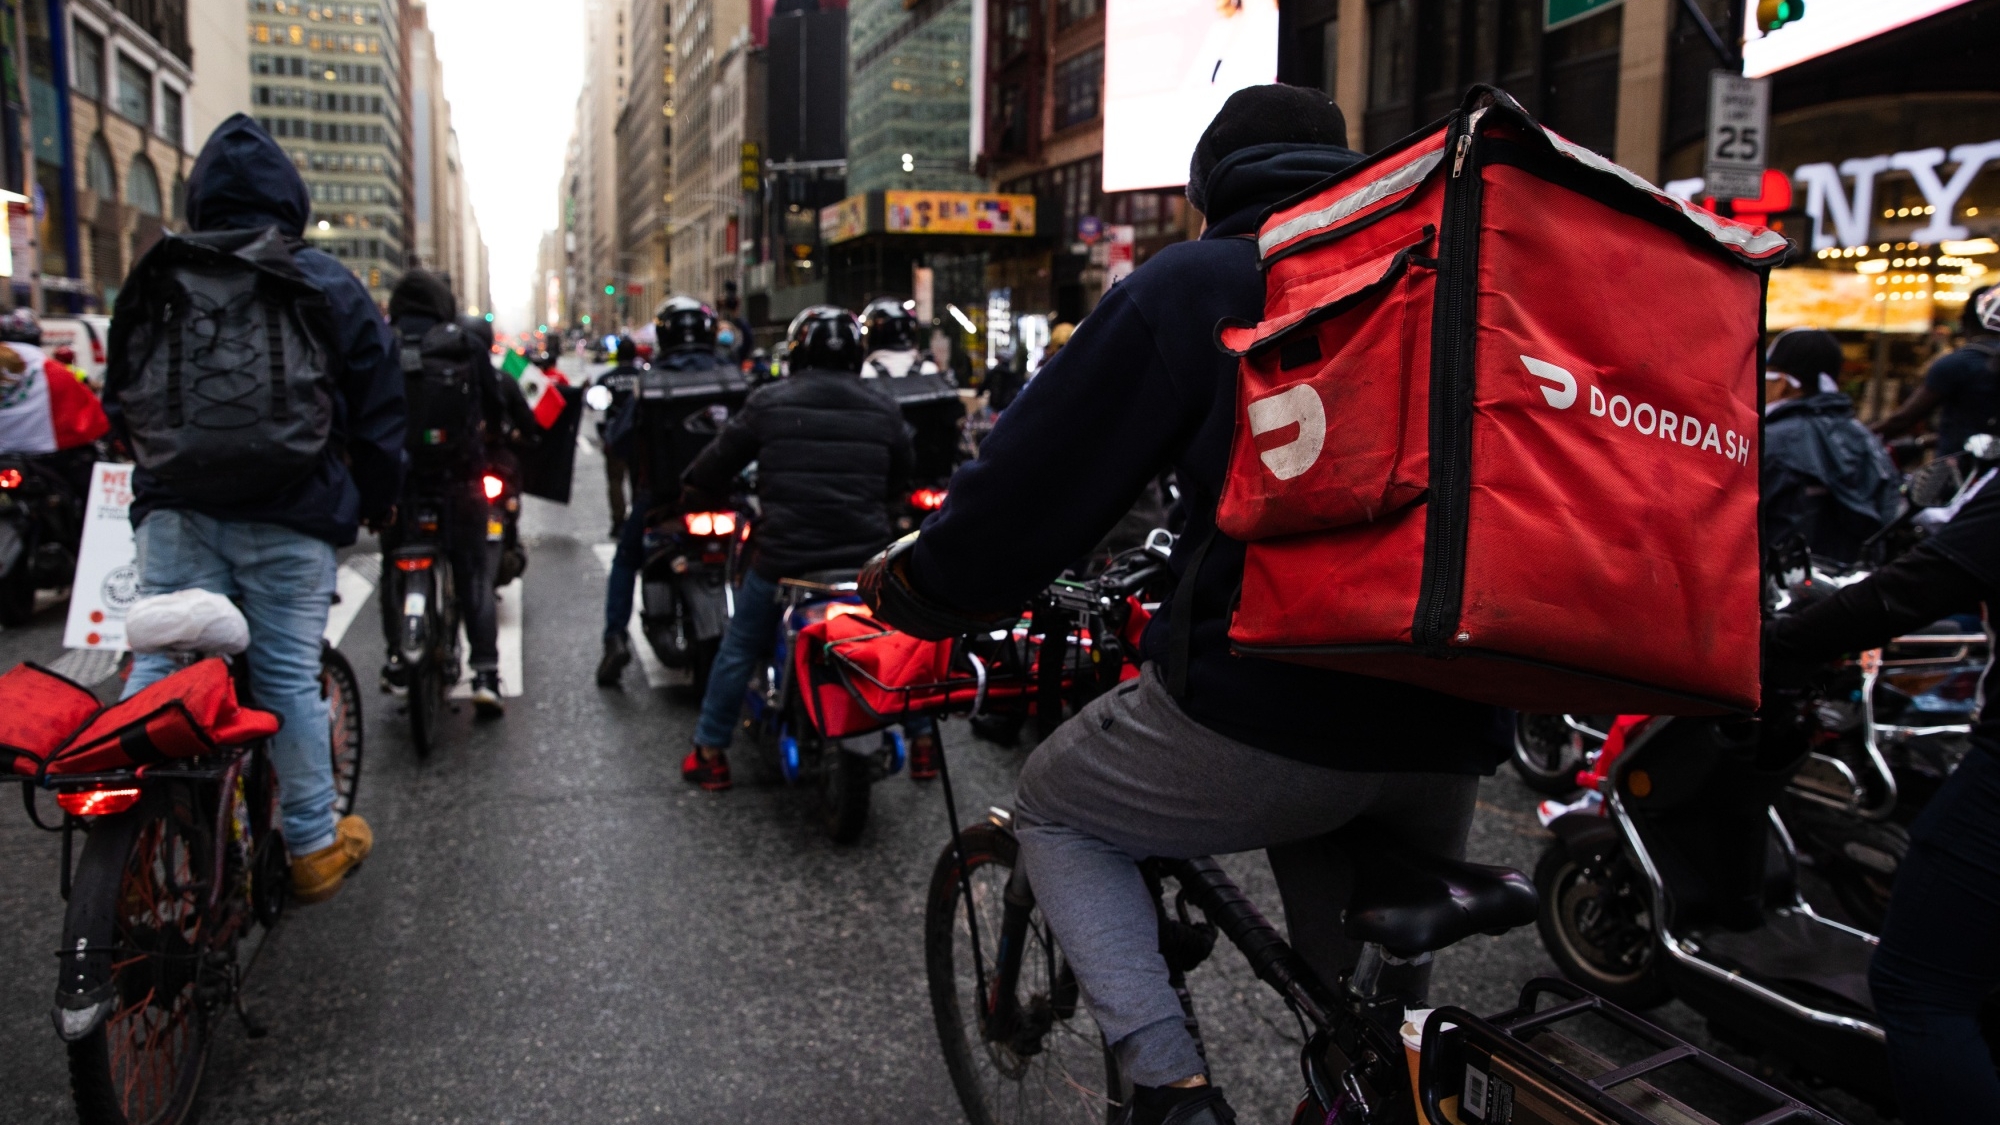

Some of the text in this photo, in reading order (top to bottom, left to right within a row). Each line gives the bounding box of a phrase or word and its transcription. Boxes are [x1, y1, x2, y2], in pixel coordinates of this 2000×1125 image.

[1717, 126, 1758, 160] 25
[1795, 139, 2000, 252] NY
[1589, 384, 1750, 467] DOORDASH
